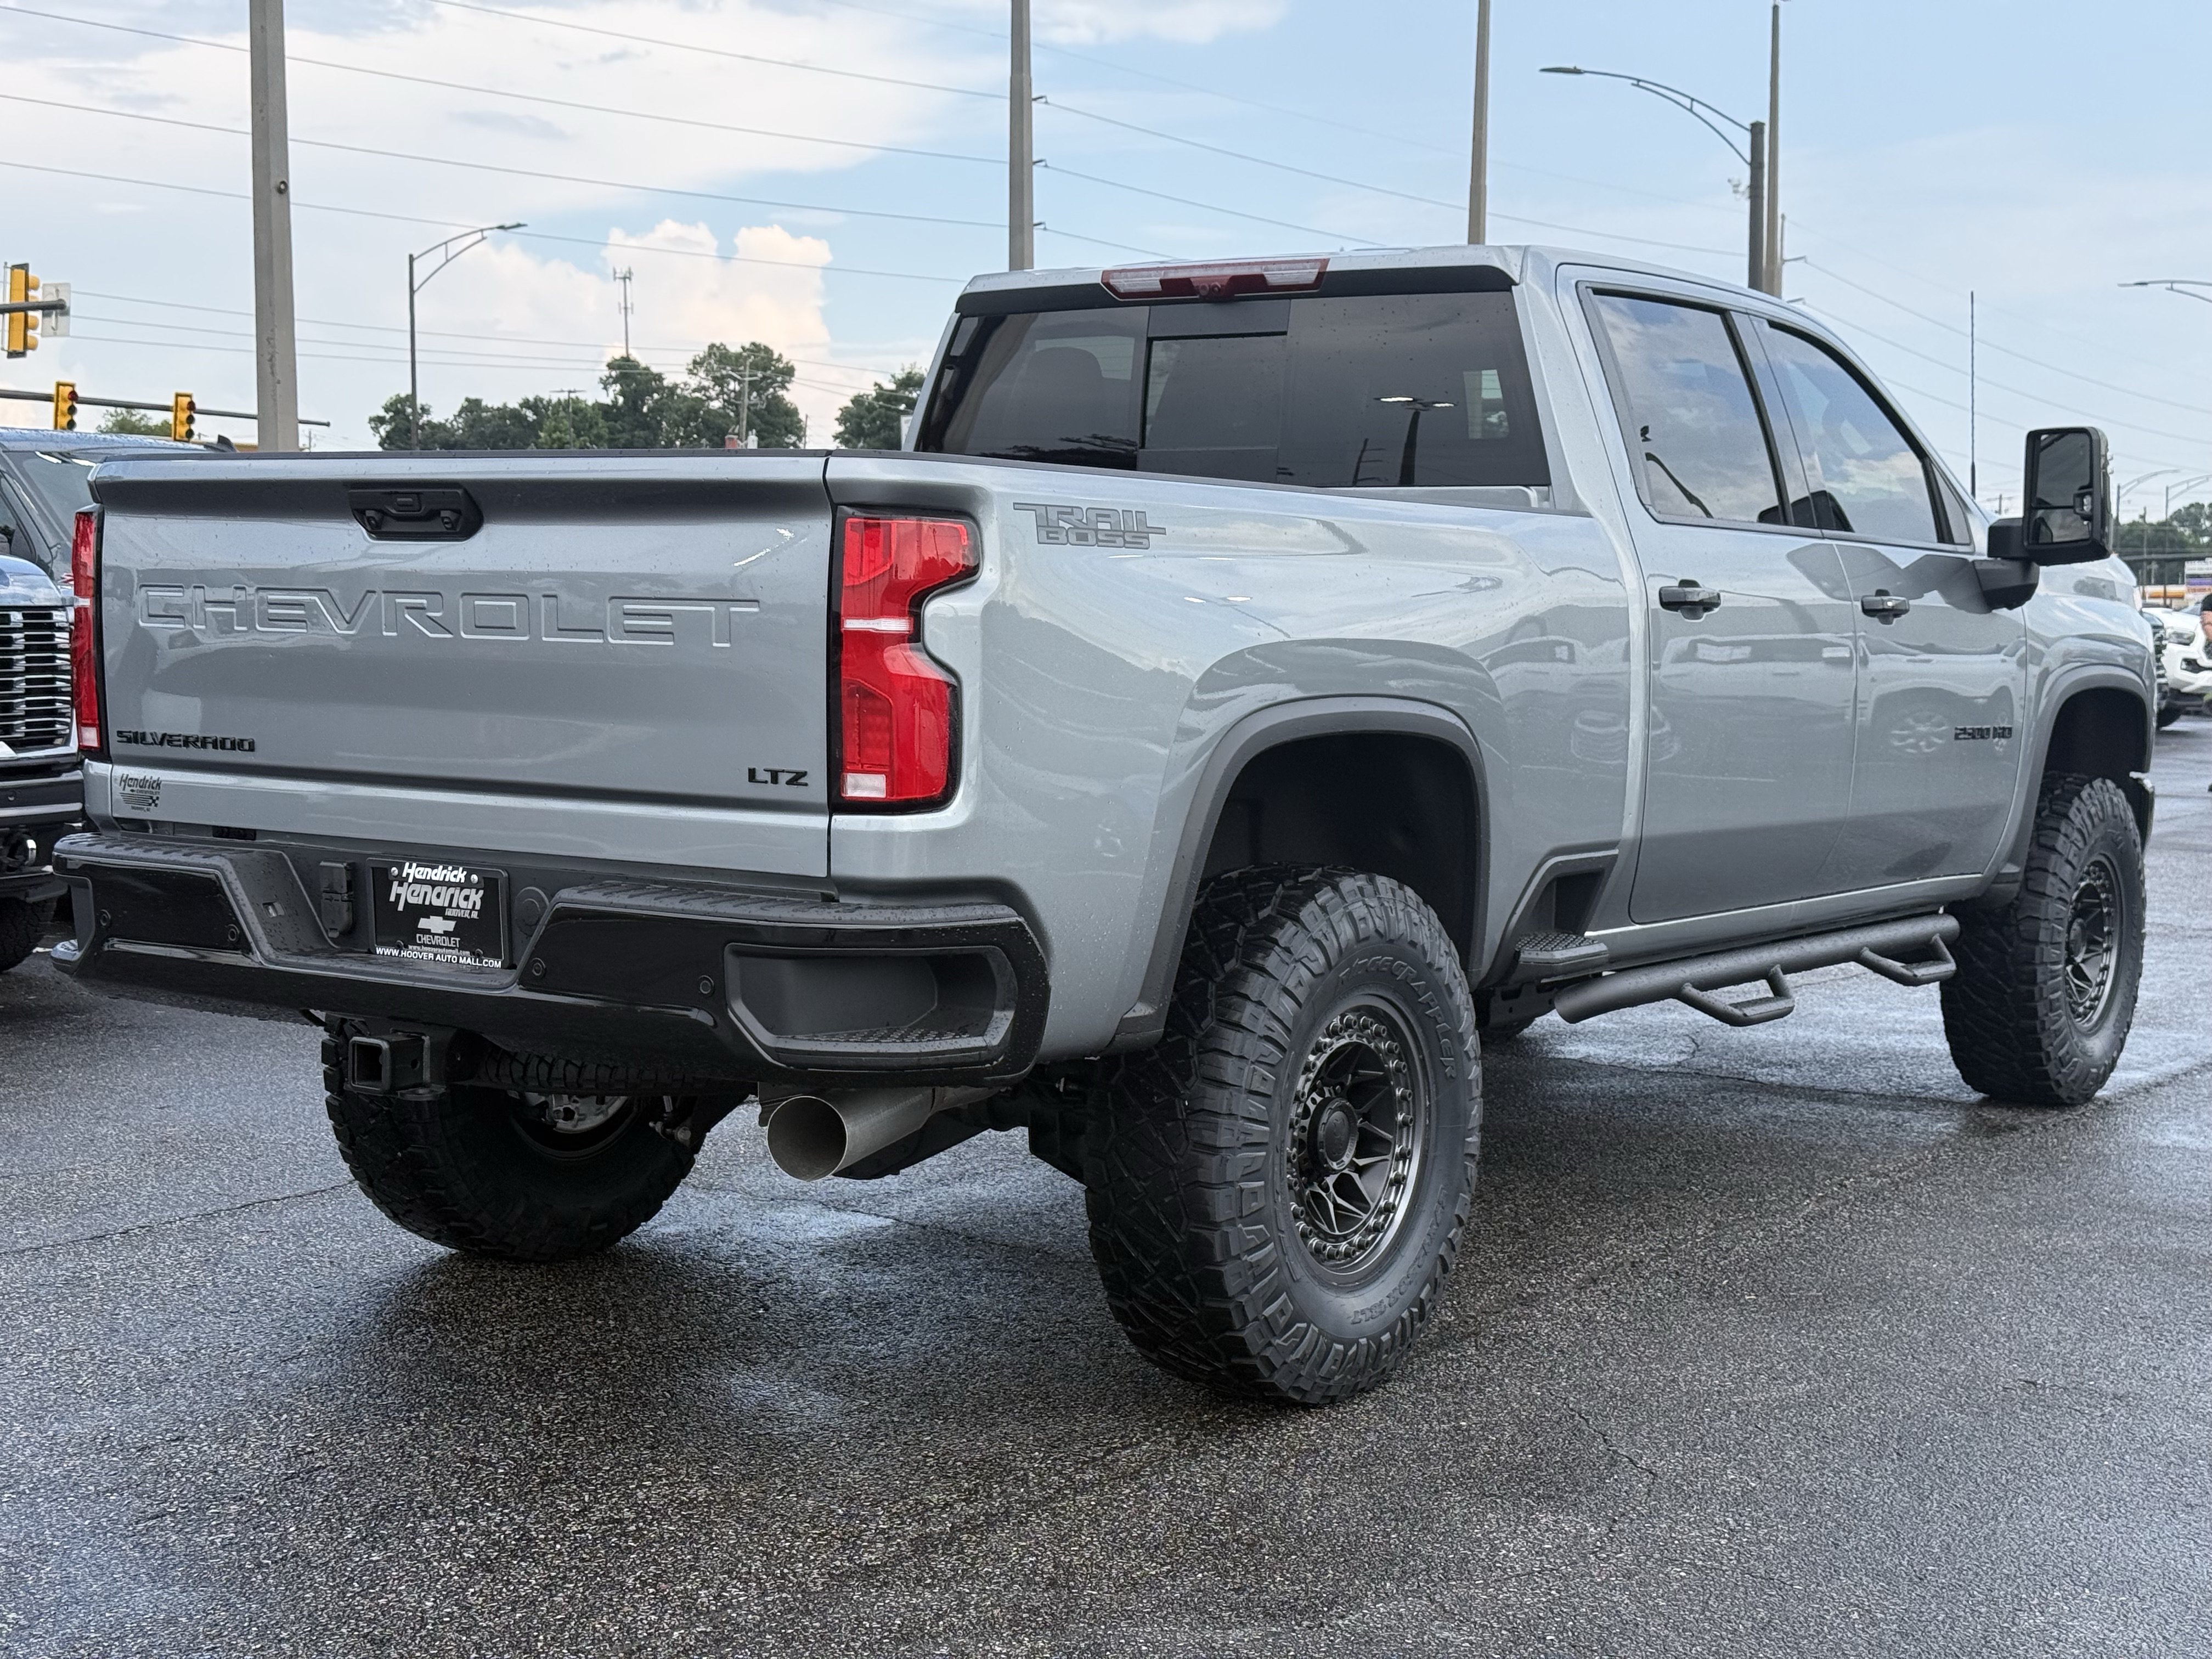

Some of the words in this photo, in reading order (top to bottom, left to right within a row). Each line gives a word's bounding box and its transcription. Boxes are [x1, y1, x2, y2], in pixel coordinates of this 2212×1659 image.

[1013, 502, 1167, 535] TRAIL
[1036, 526, 1150, 550] BOSS
[138, 583, 760, 647] CHEVROLET
[116, 730, 256, 753] SILVERADO
[119, 773, 162, 791] Hendrick
[747, 767, 809, 787] LTZ
[402, 862, 467, 883] Hendrick
[390, 881, 484, 911] Hendrick
[416, 934, 460, 947] CHEVROLET
[376, 947, 434, 961] WWW.HOOVER
[435, 954, 458, 963] AUTO
[459, 957, 502, 968] MALL.COM
